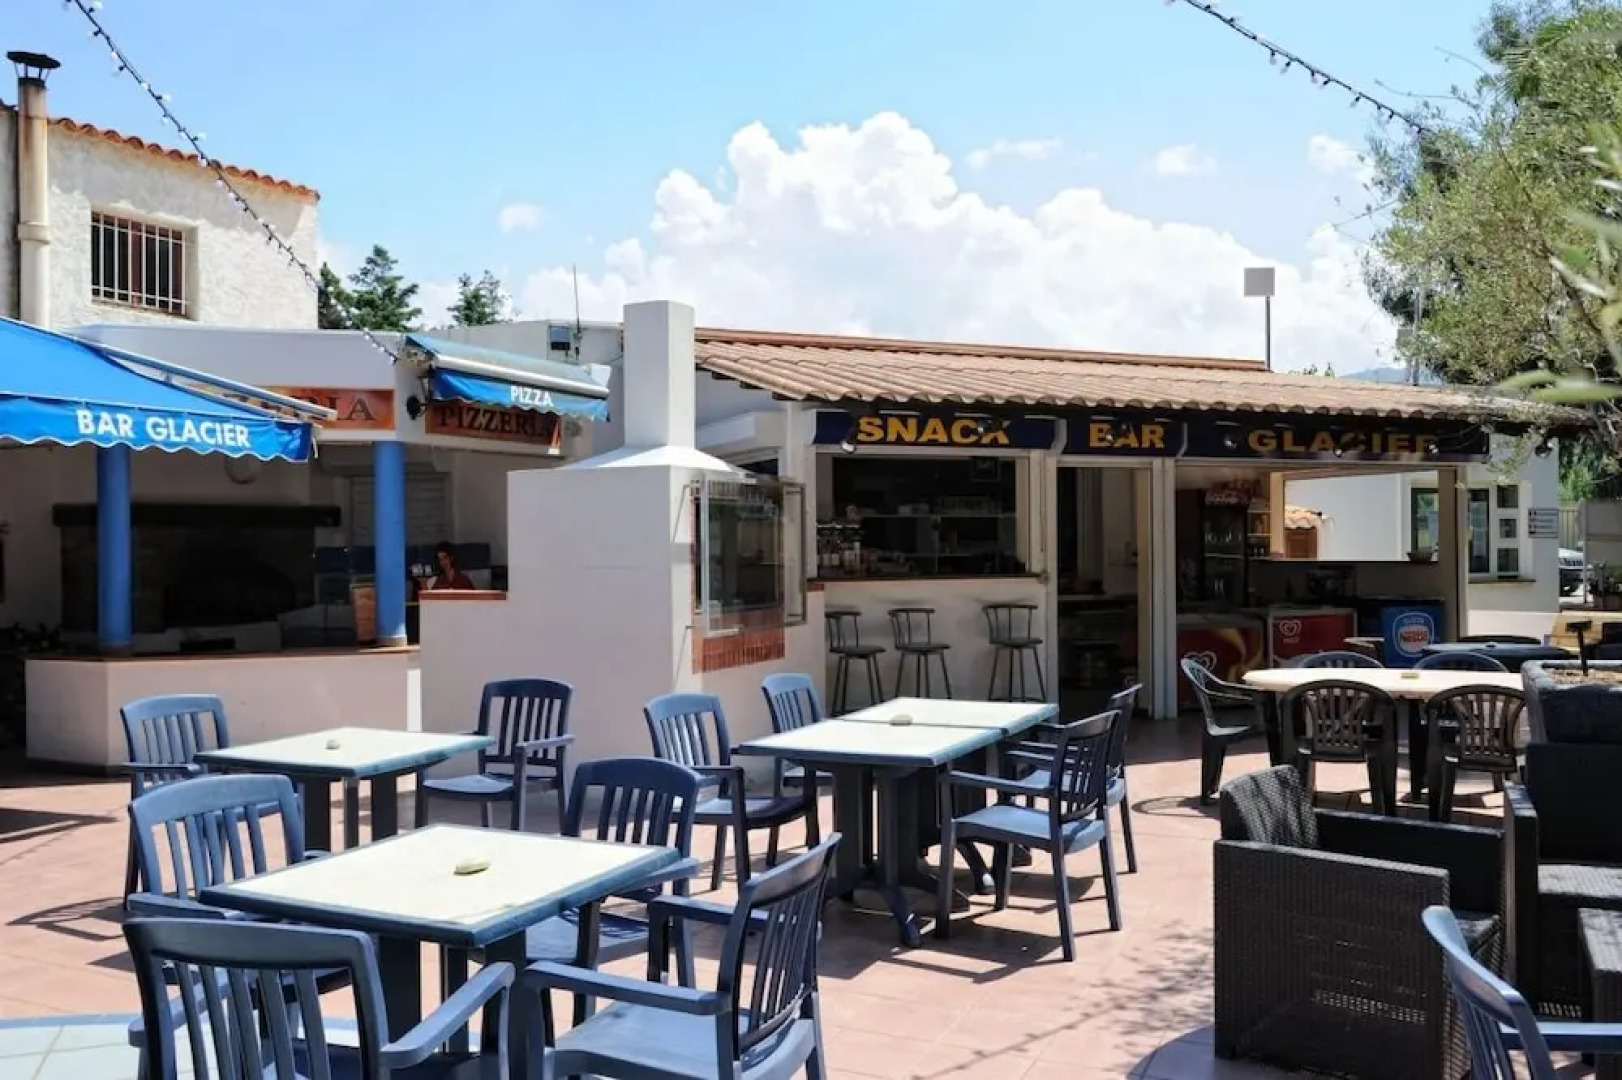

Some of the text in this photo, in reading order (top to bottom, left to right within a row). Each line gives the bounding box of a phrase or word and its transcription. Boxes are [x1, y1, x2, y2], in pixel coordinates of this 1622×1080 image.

[510, 384, 554, 408] PIZZA
[77, 409, 250, 448] BAR GLACIER
[1089, 422, 1165, 449] BAR
